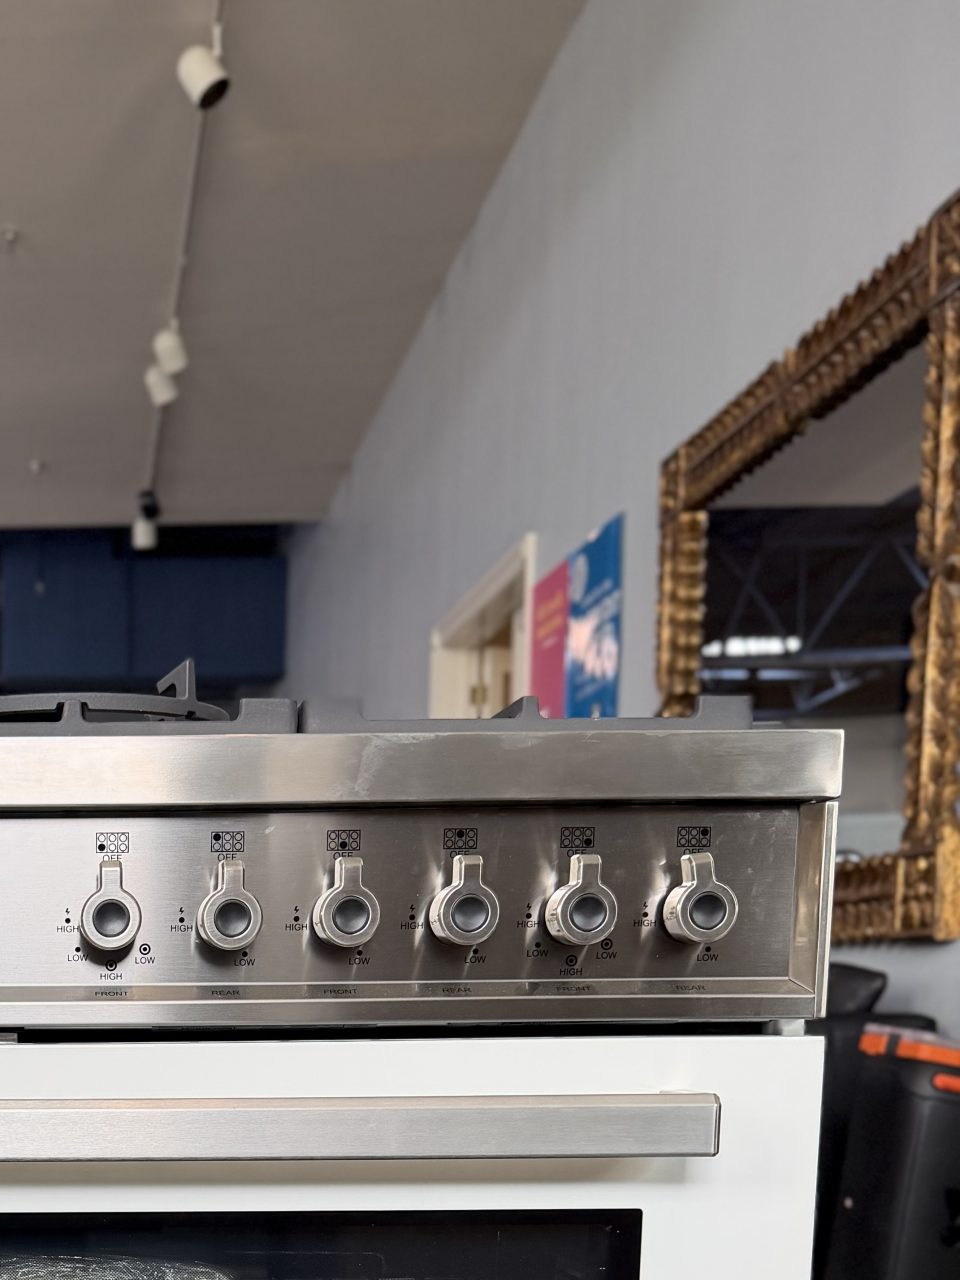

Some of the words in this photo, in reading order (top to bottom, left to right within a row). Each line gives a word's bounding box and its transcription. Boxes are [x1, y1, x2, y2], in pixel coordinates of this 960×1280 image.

[217, 853, 237, 861] OFF
[333, 851, 353, 860] OFF
[449, 850, 470, 858] OFF
[566, 849, 587, 857] OFF
[285, 923, 307, 931] HIGH
[400, 922, 424, 930] HIGH
[517, 920, 540, 928] HIGH
[633, 919, 657, 927] HIGH
[56, 925, 79, 933] HIGH
[170, 924, 193, 932] HIGH
[526, 949, 548, 958] LOW
[596, 952, 617, 960] LOW
[67, 954, 89, 962] LOW
[134, 956, 155, 965] LOW
[233, 958, 256, 966] LOW
[348, 957, 370, 965] LOW
[464, 955, 486, 964] LOW
[696, 954, 719, 962] LOW
[559, 968, 583, 976] HIGH
[100, 973, 123, 981] HIGH
